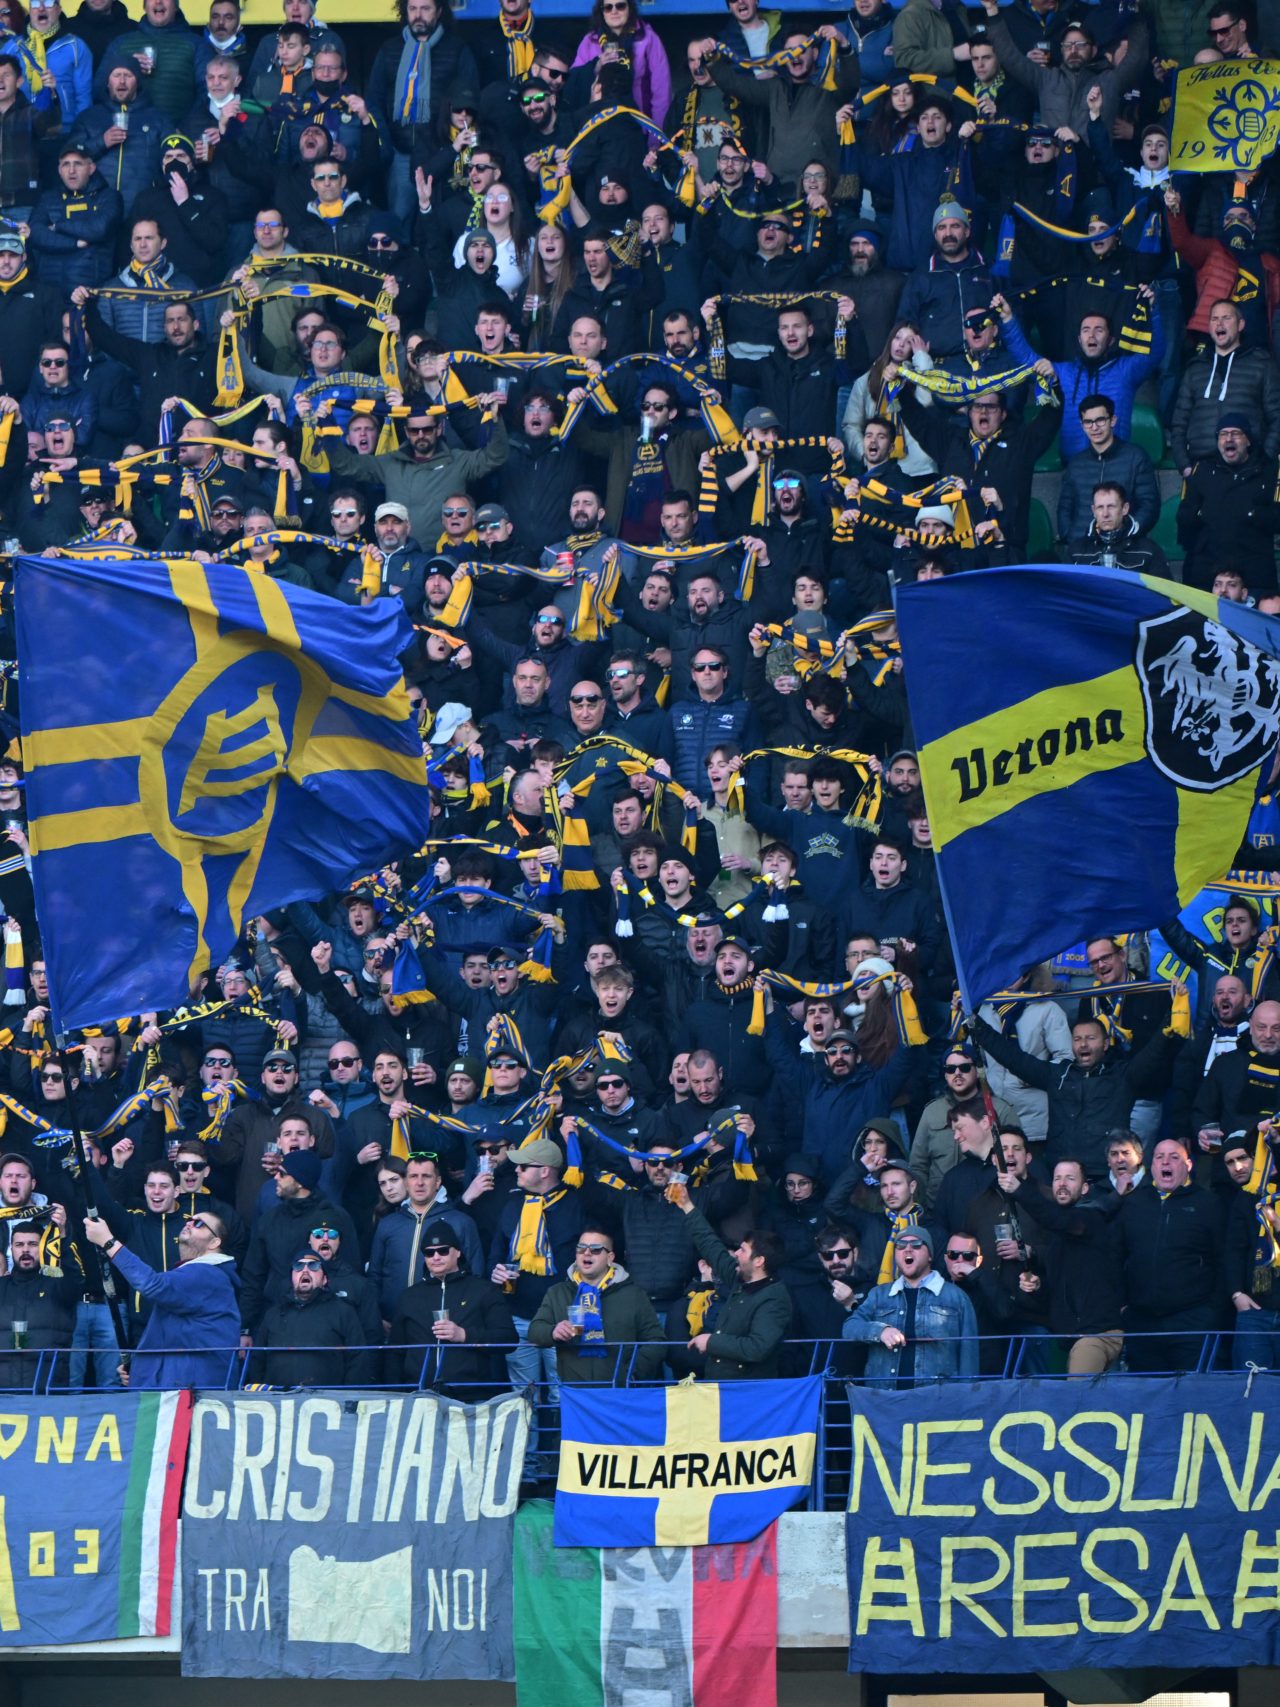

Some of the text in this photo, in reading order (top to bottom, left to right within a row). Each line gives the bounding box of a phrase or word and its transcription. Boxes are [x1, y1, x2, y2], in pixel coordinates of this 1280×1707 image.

[1186, 64, 1241, 86] Hellas
[1176, 140, 1206, 159] 19
[951, 707, 1124, 803] Verona
[185, 1398, 531, 1523] CRISTIANO
[577, 1444, 797, 1490] VILLAFRANCA
[28, 1528, 100, 1578] 03
[198, 1568, 271, 1632] TRA
[427, 1568, 487, 1632] NOI
